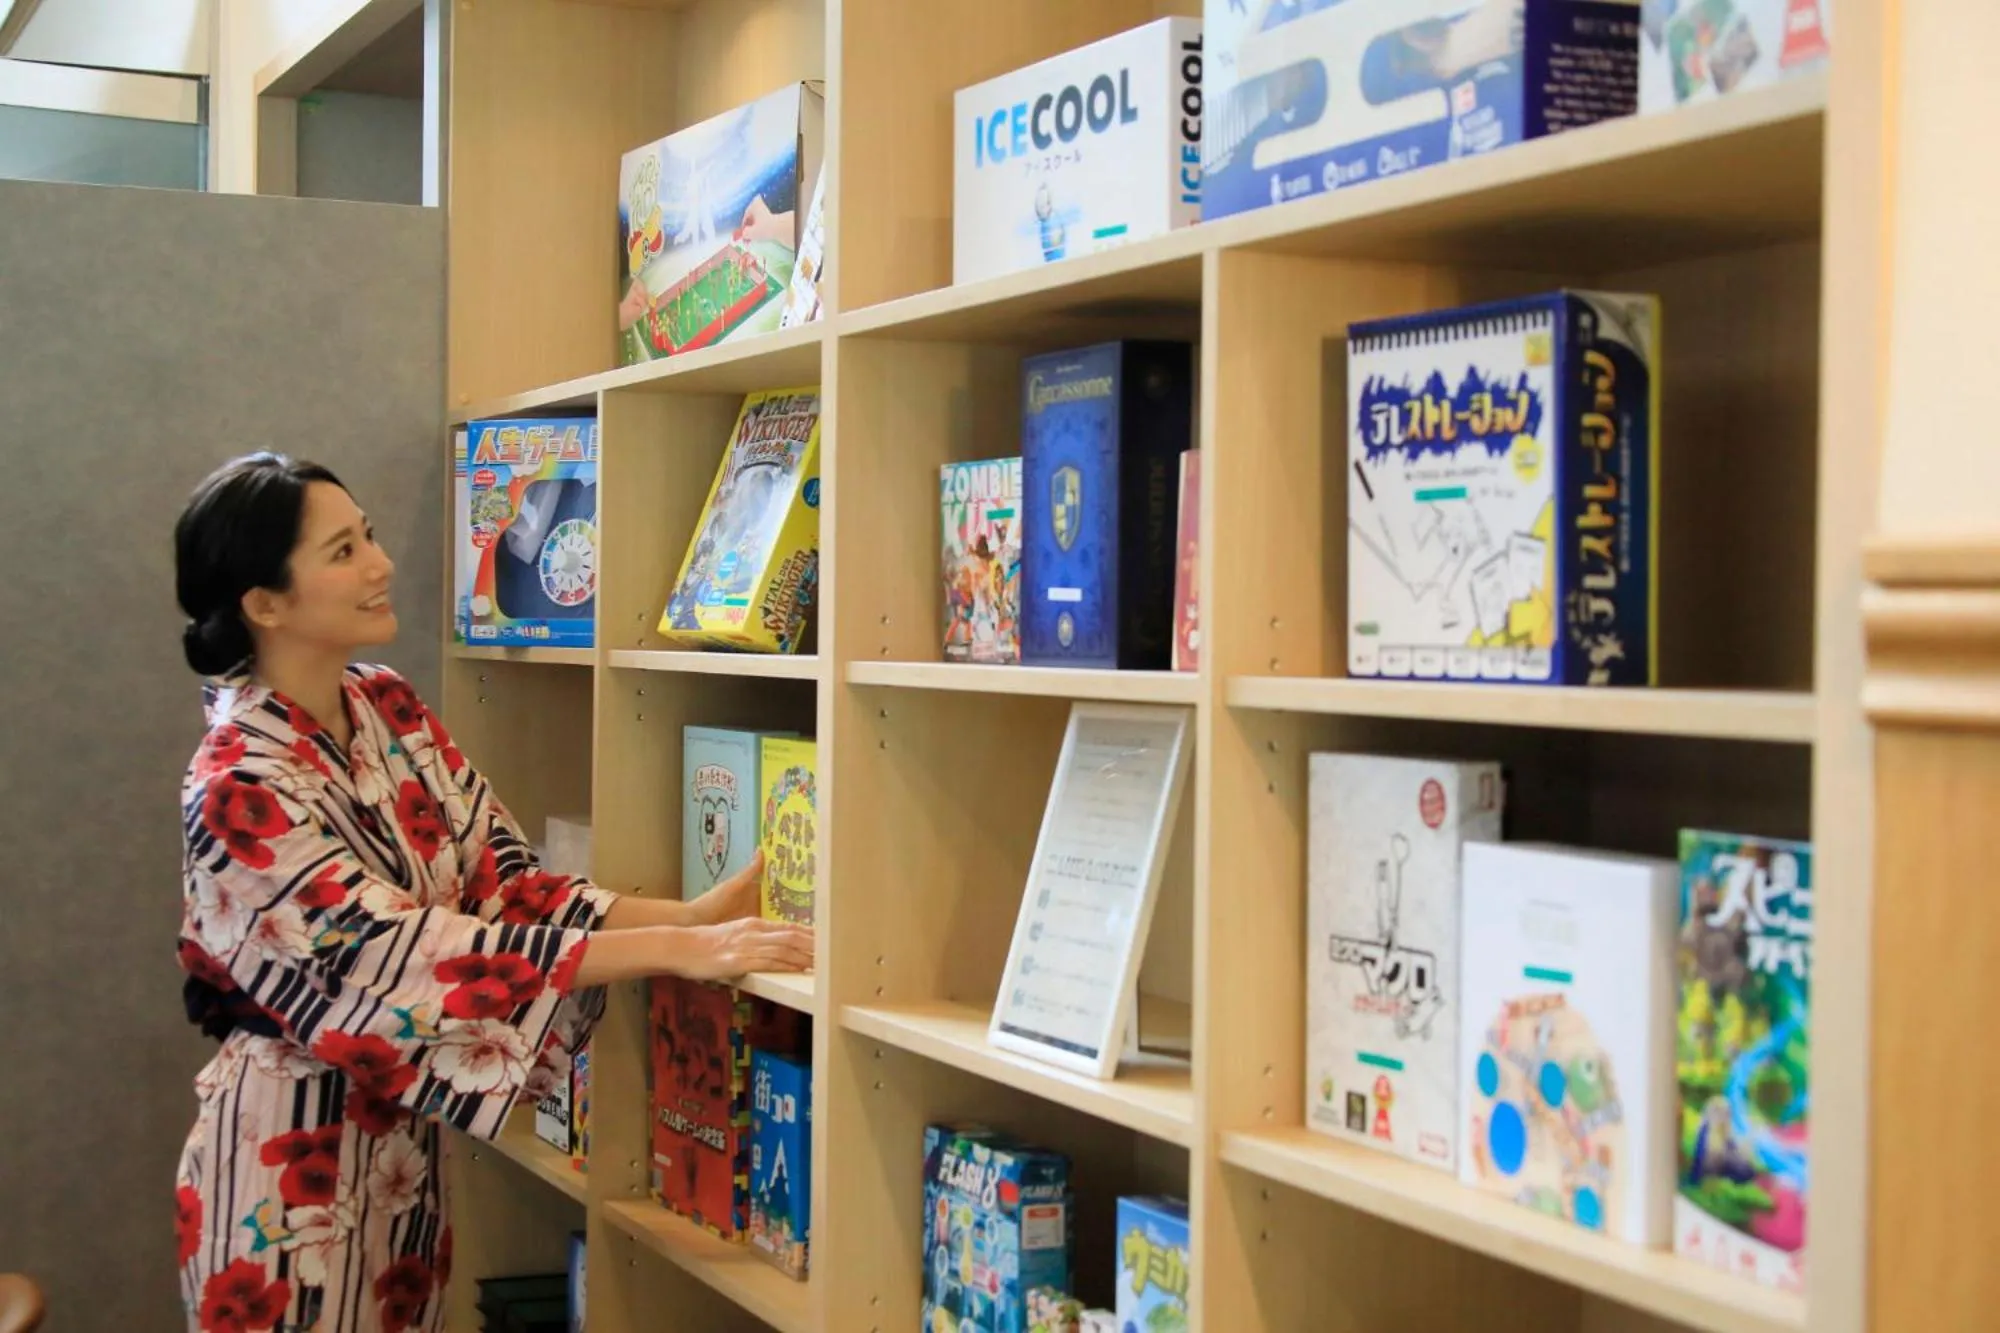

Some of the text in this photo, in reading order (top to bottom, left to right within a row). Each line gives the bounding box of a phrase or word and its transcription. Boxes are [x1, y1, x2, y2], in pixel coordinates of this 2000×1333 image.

[974, 67, 1138, 169] ICECOOL
[1181, 33, 1202, 205] ICECOOL
[472, 424, 587, 464] 人生ゲーム
[737, 412, 818, 447] WIKINGER
[1370, 390, 1530, 446] テレストレーション
[940, 460, 1023, 503] ZOMBIE
[754, 1068, 796, 1124] 街コロ
[938, 1152, 1000, 1209] FLASH 8
